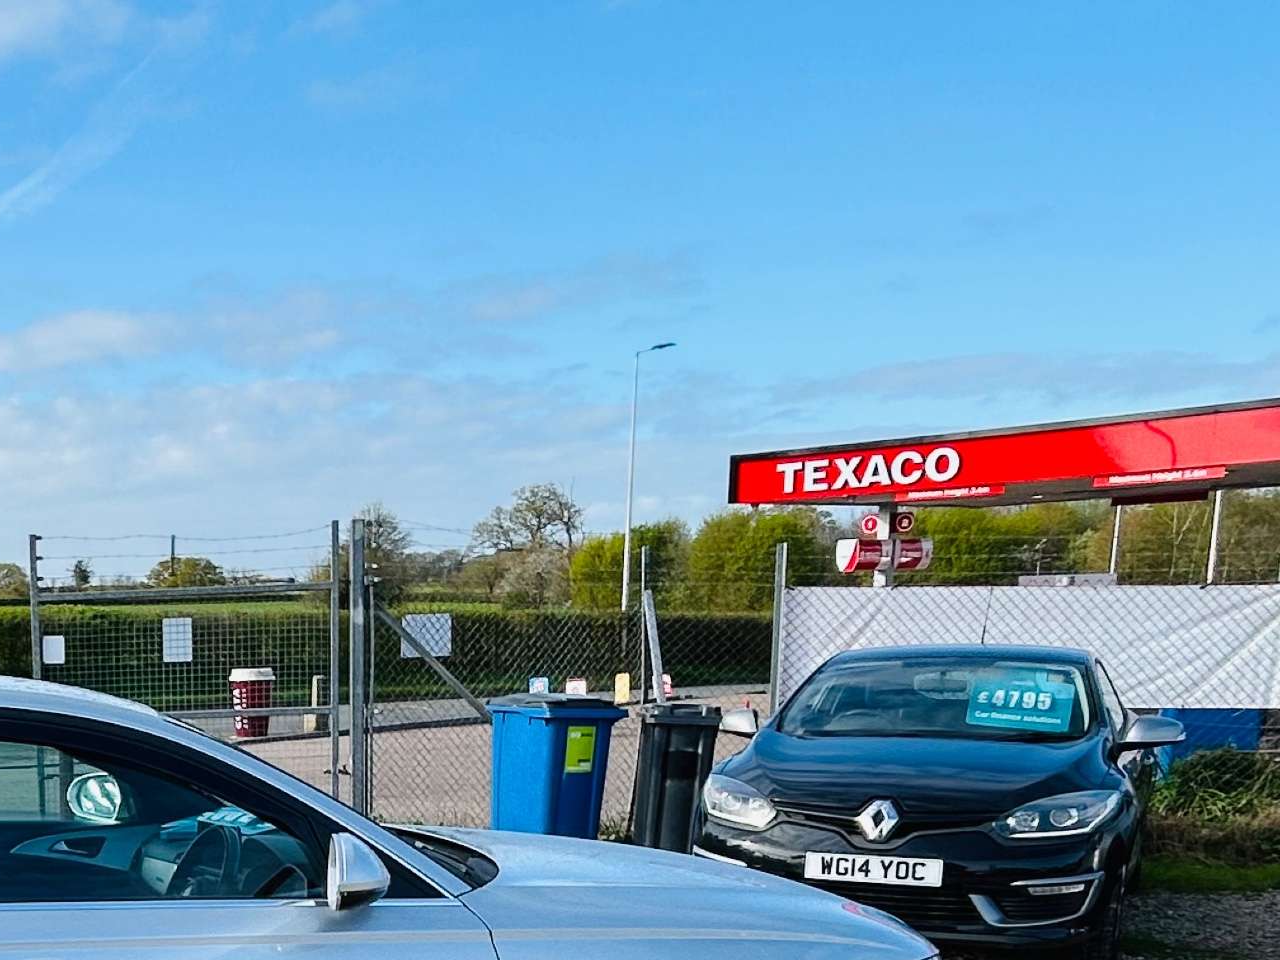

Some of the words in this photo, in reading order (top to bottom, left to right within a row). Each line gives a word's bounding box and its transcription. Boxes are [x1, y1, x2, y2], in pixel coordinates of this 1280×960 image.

[776, 447, 960, 494] TEXACO
[977, 689, 1052, 710] £4795
[820, 855, 871, 878] WG14
[880, 859, 927, 881] YOC
